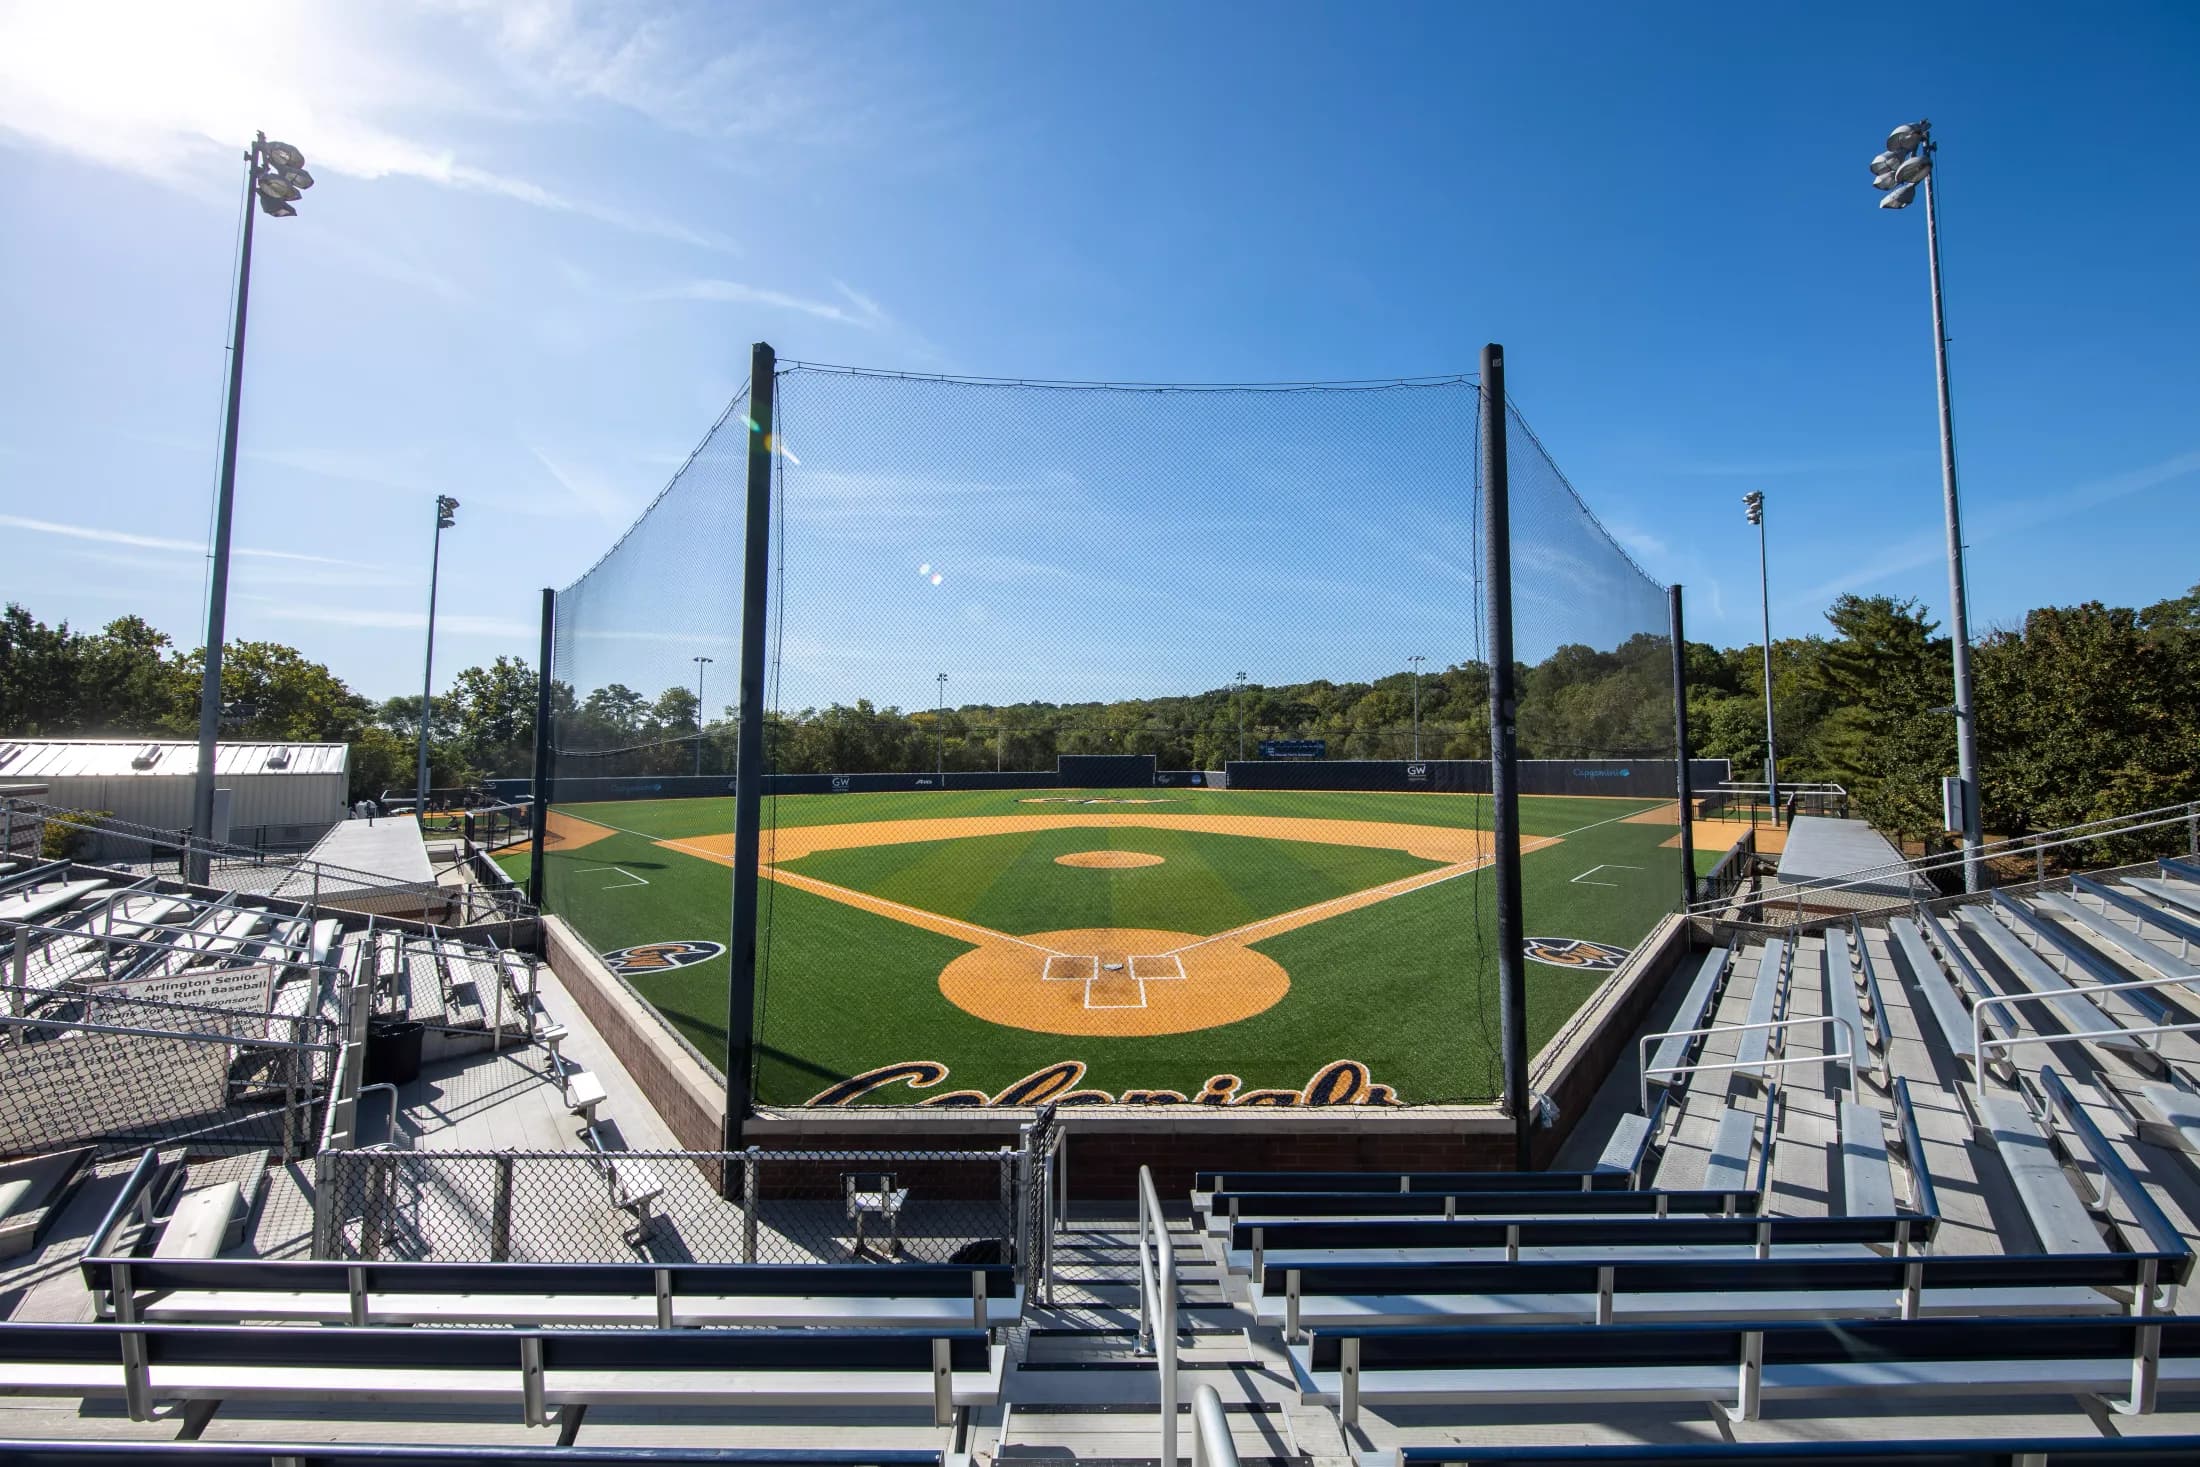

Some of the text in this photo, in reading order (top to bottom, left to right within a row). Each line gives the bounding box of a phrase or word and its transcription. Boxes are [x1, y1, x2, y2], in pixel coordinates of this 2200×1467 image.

[1408, 766, 1426, 775] GW
[832, 777, 849, 786] GW
[145, 973, 258, 993] Arlington Senior
[174, 986, 206, 998] Ruth
[211, 981, 267, 994] Baseball
[203, 994, 261, 1008] Sponsors!
